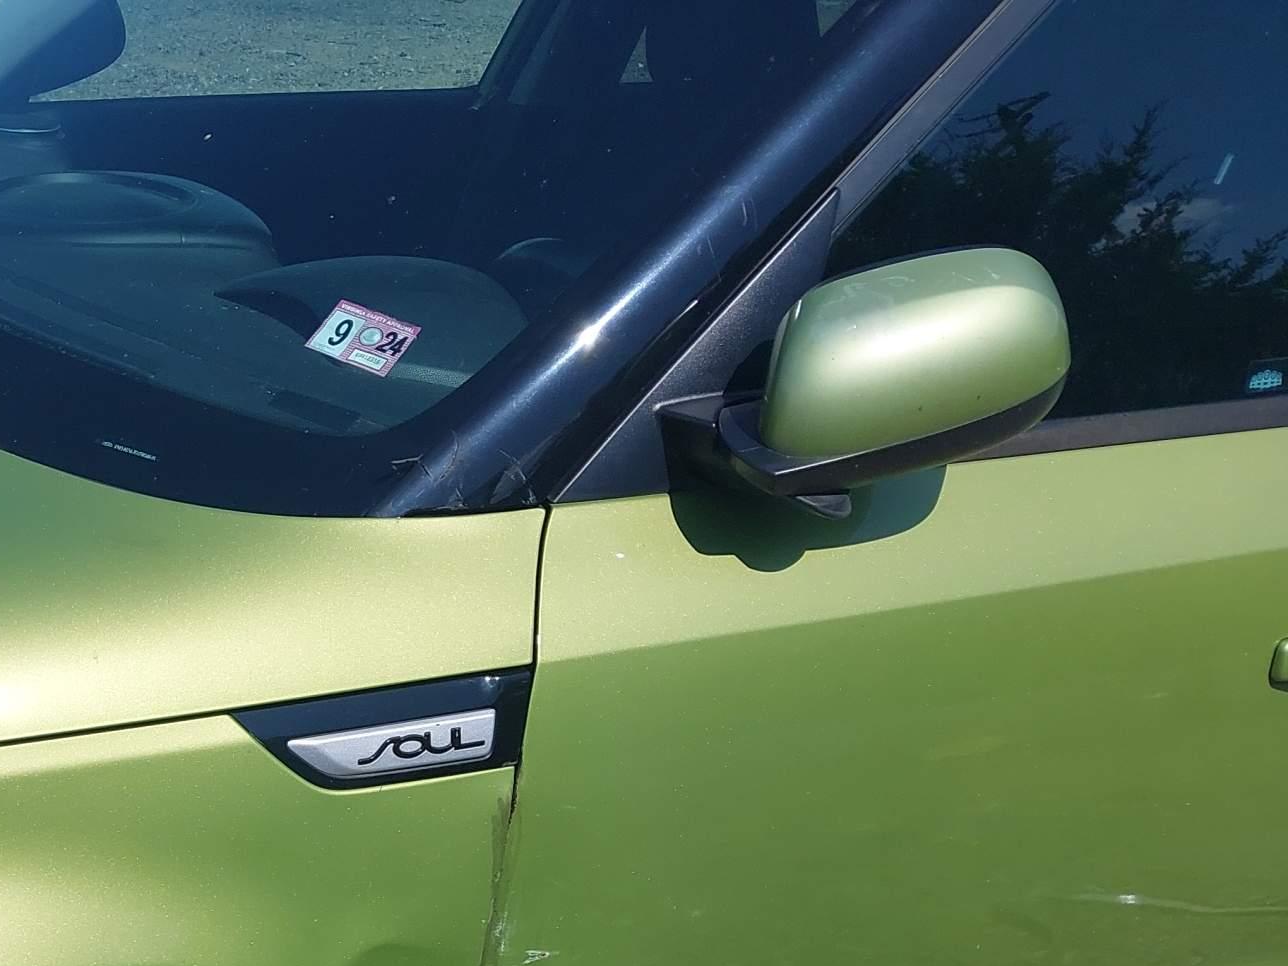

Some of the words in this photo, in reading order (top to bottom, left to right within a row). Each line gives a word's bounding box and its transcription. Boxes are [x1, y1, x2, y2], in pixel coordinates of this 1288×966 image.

[328, 319, 354, 346] 9
[375, 331, 409, 357] 24
[357, 727, 486, 766] SOUL
